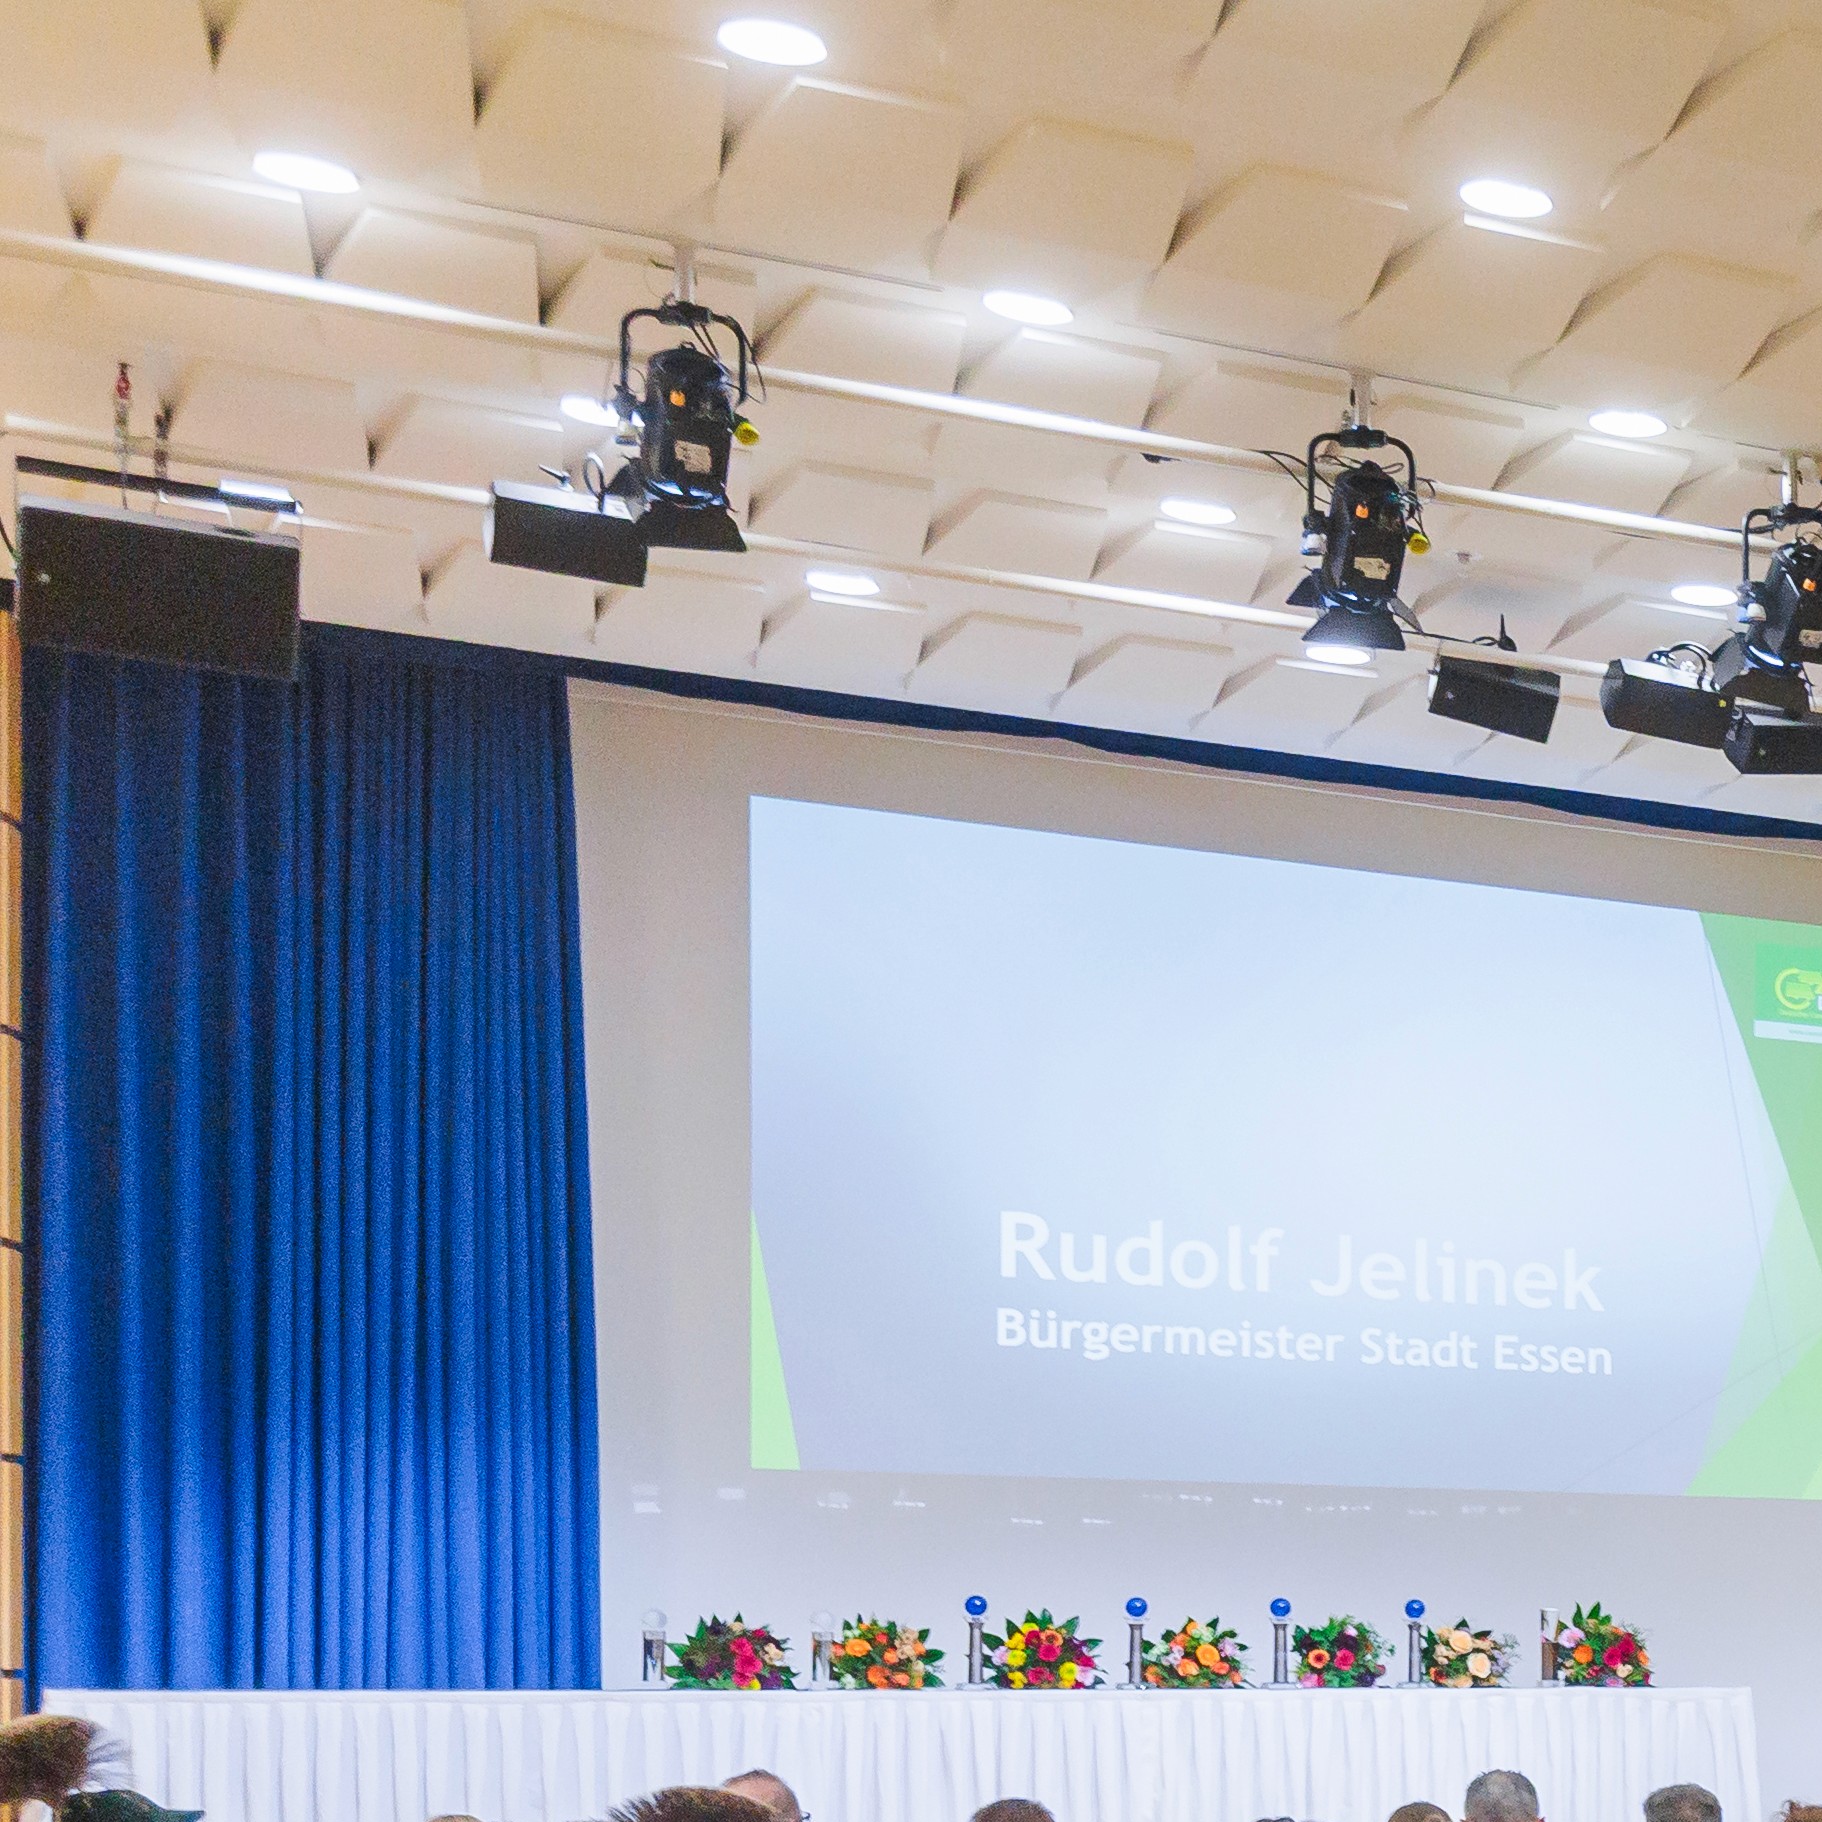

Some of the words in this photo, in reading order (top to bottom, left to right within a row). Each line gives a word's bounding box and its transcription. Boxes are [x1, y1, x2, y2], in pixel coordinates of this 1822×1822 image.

[1000, 1210, 1285, 1293] Rudolf
[1310, 1234, 1606, 1312] Jelinek
[996, 1307, 1345, 1362] Bürgermeister
[1360, 1327, 1479, 1370] Stadt
[1494, 1334, 1613, 1376] Essen
